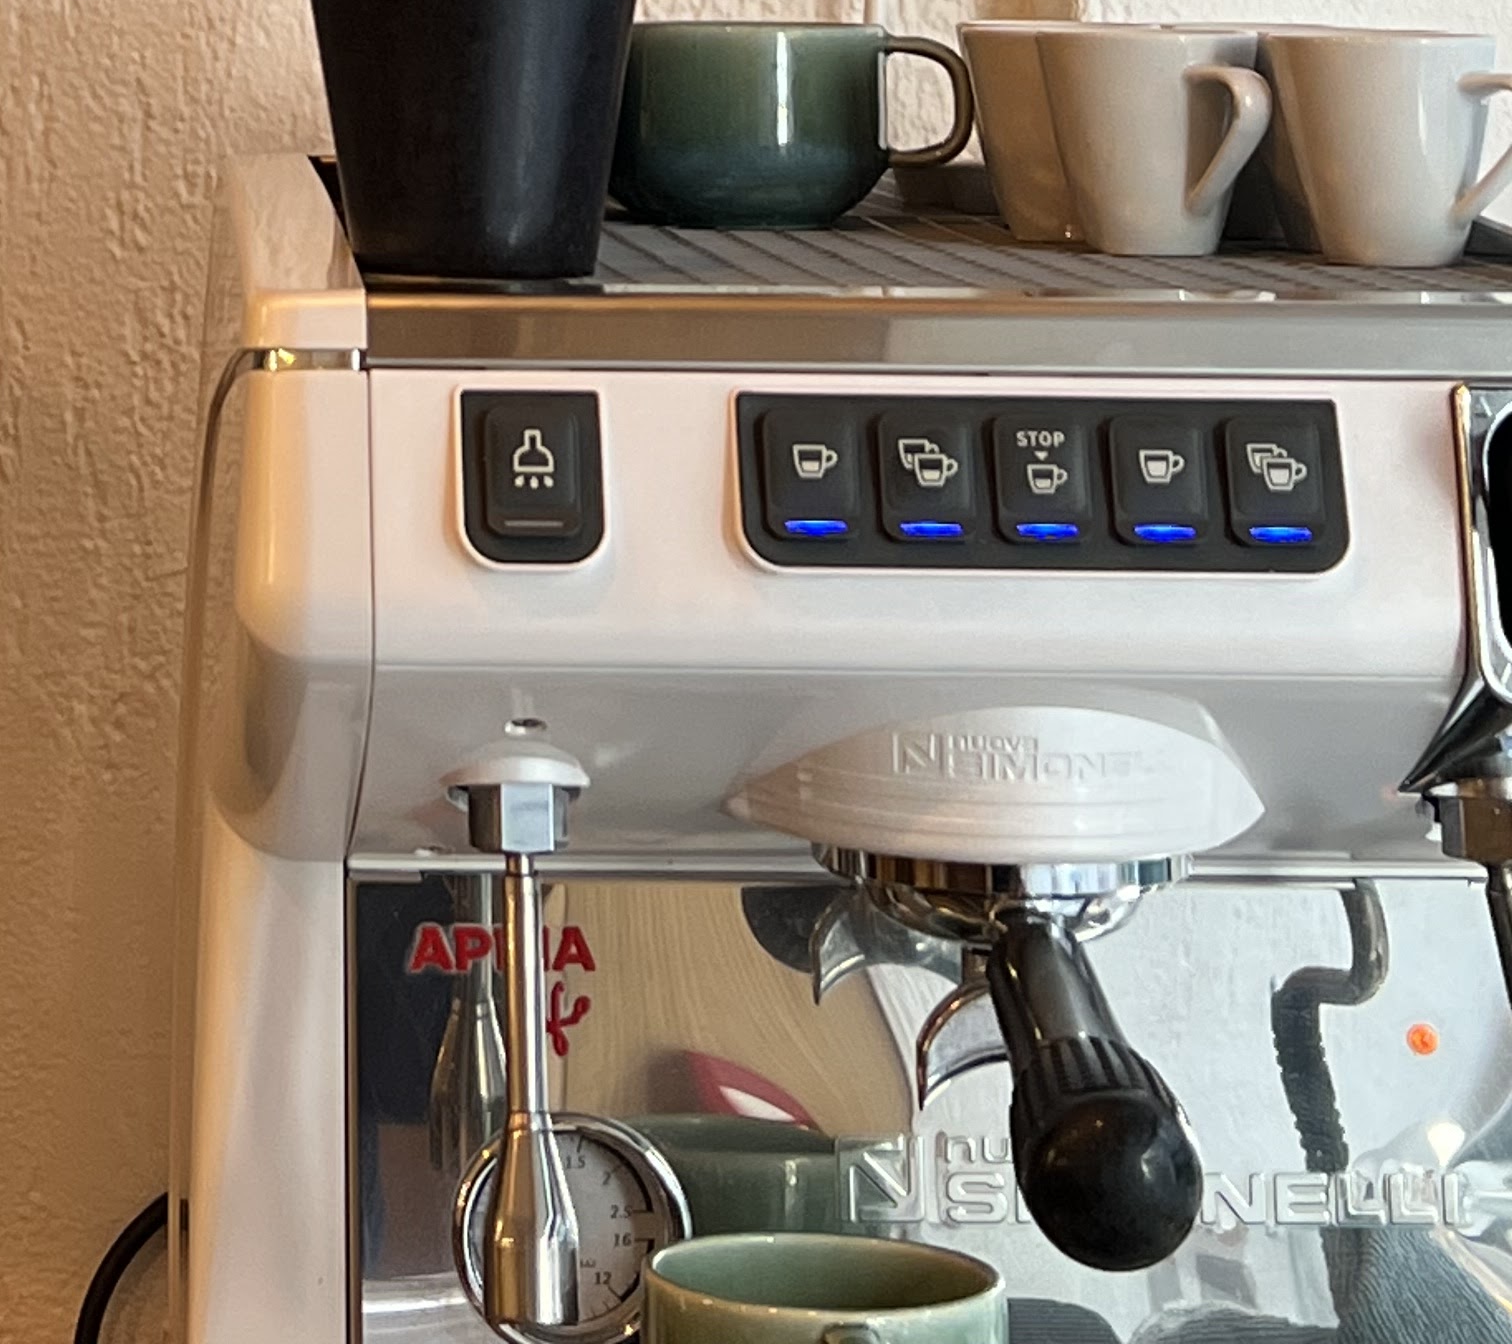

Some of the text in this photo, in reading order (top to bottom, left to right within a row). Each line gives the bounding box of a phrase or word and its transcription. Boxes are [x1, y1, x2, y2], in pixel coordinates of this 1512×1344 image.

[1016, 430, 1065, 447] STOP
[614, 1233, 632, 1247] 16
[595, 1271, 613, 1285] 12
